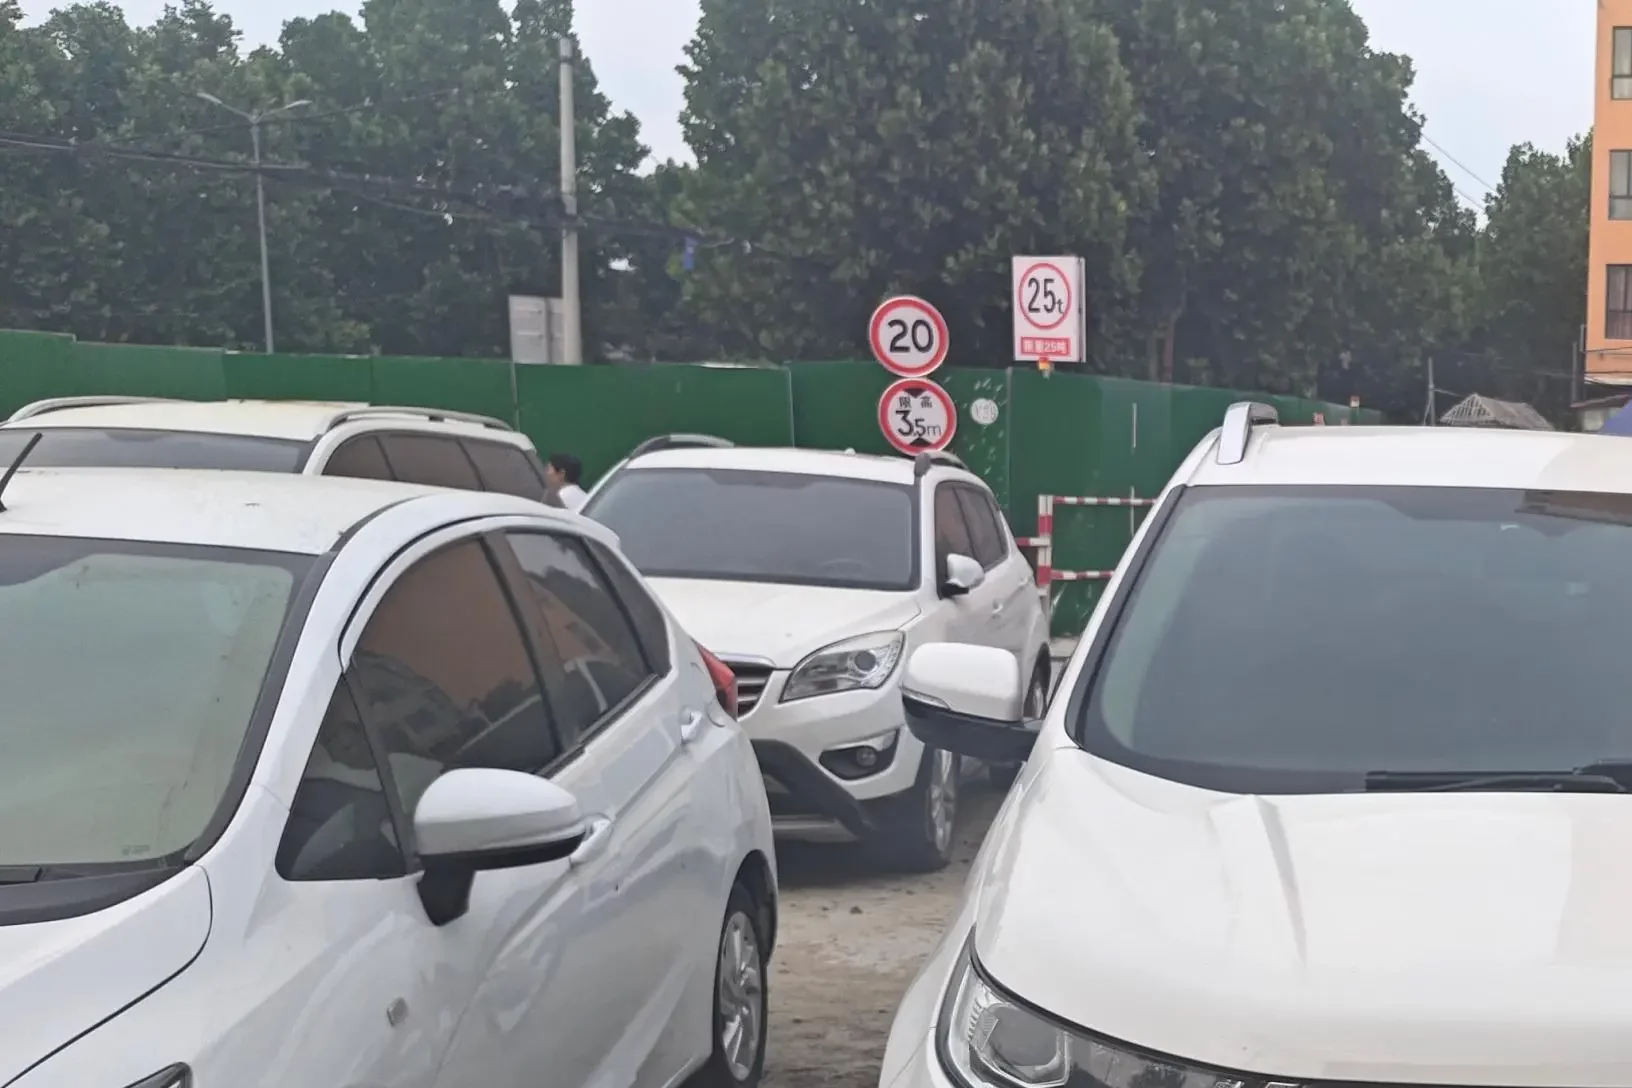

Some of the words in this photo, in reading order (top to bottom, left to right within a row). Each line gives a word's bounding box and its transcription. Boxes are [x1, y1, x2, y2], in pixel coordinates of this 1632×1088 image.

[1027, 277, 1063, 314] 25t
[887, 319, 933, 353] 20
[898, 396, 933, 409] 限高
